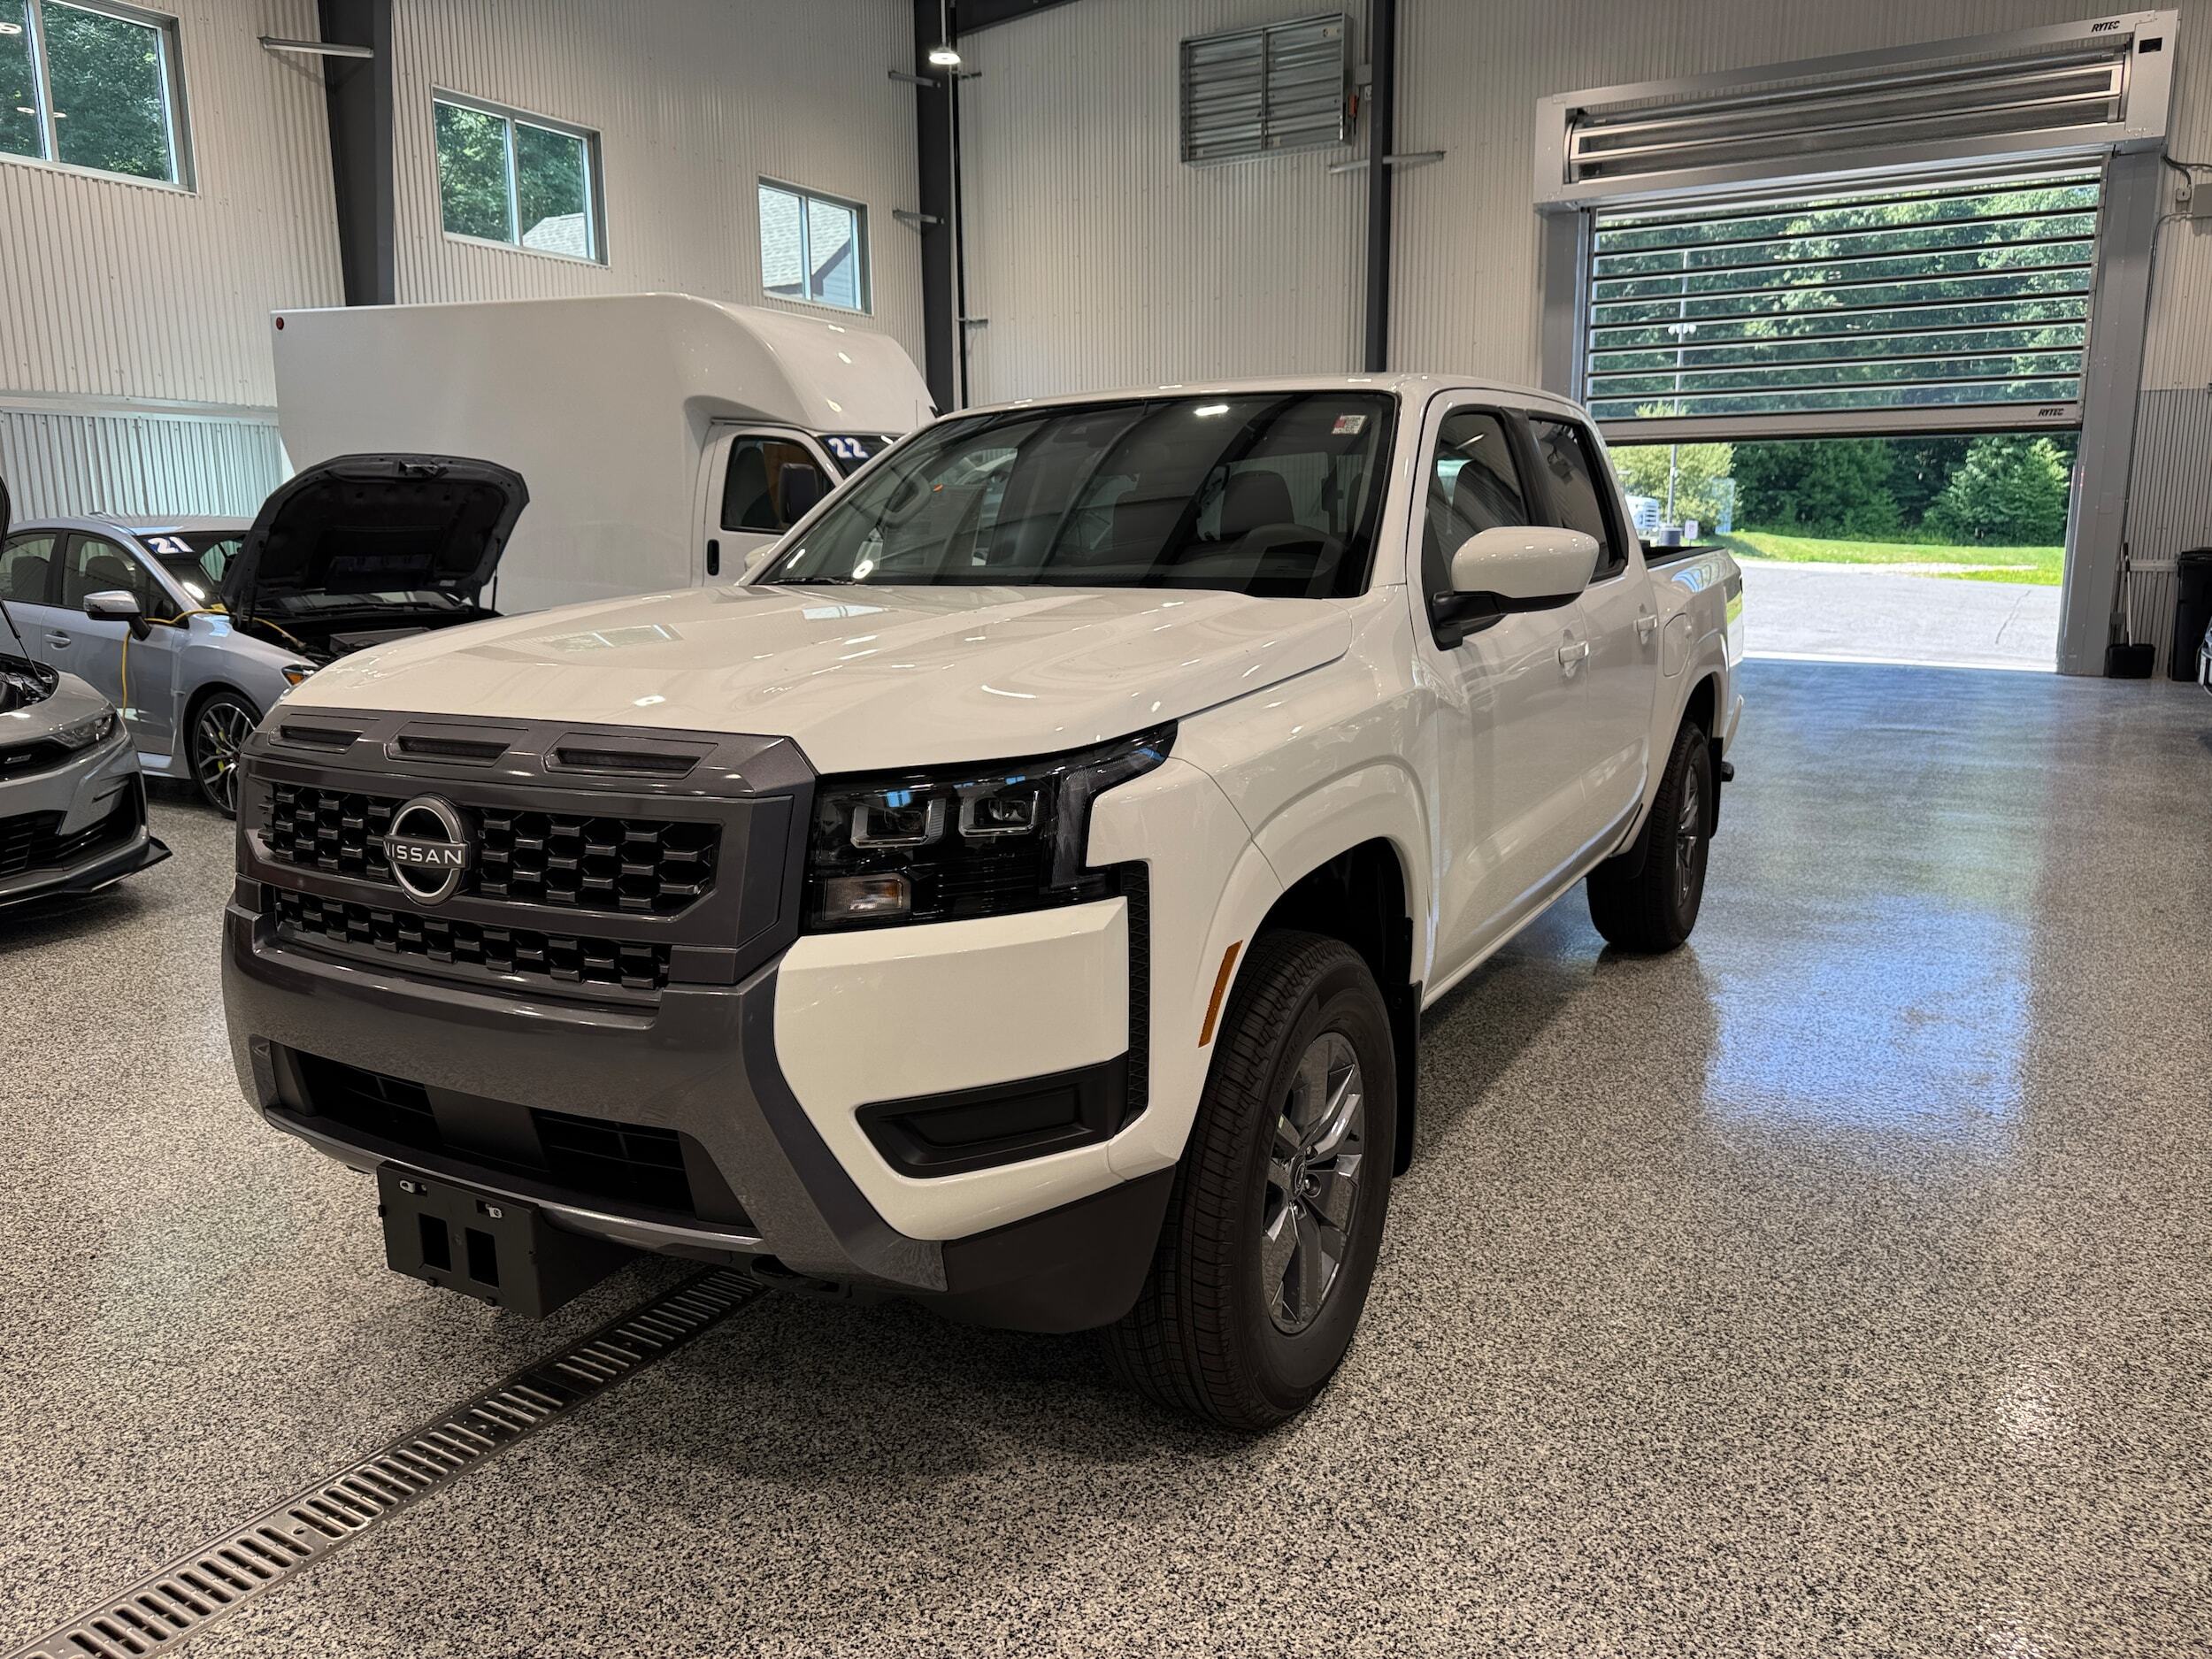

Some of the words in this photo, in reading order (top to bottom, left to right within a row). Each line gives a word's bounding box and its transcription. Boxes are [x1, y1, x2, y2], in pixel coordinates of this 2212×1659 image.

[2091, 20, 2120, 33] RYTEC
[2038, 407, 2064, 417] RYTEC
[827, 437, 869, 458] 22
[147, 535, 195, 555] 21
[383, 841, 462, 864] NISSAN
